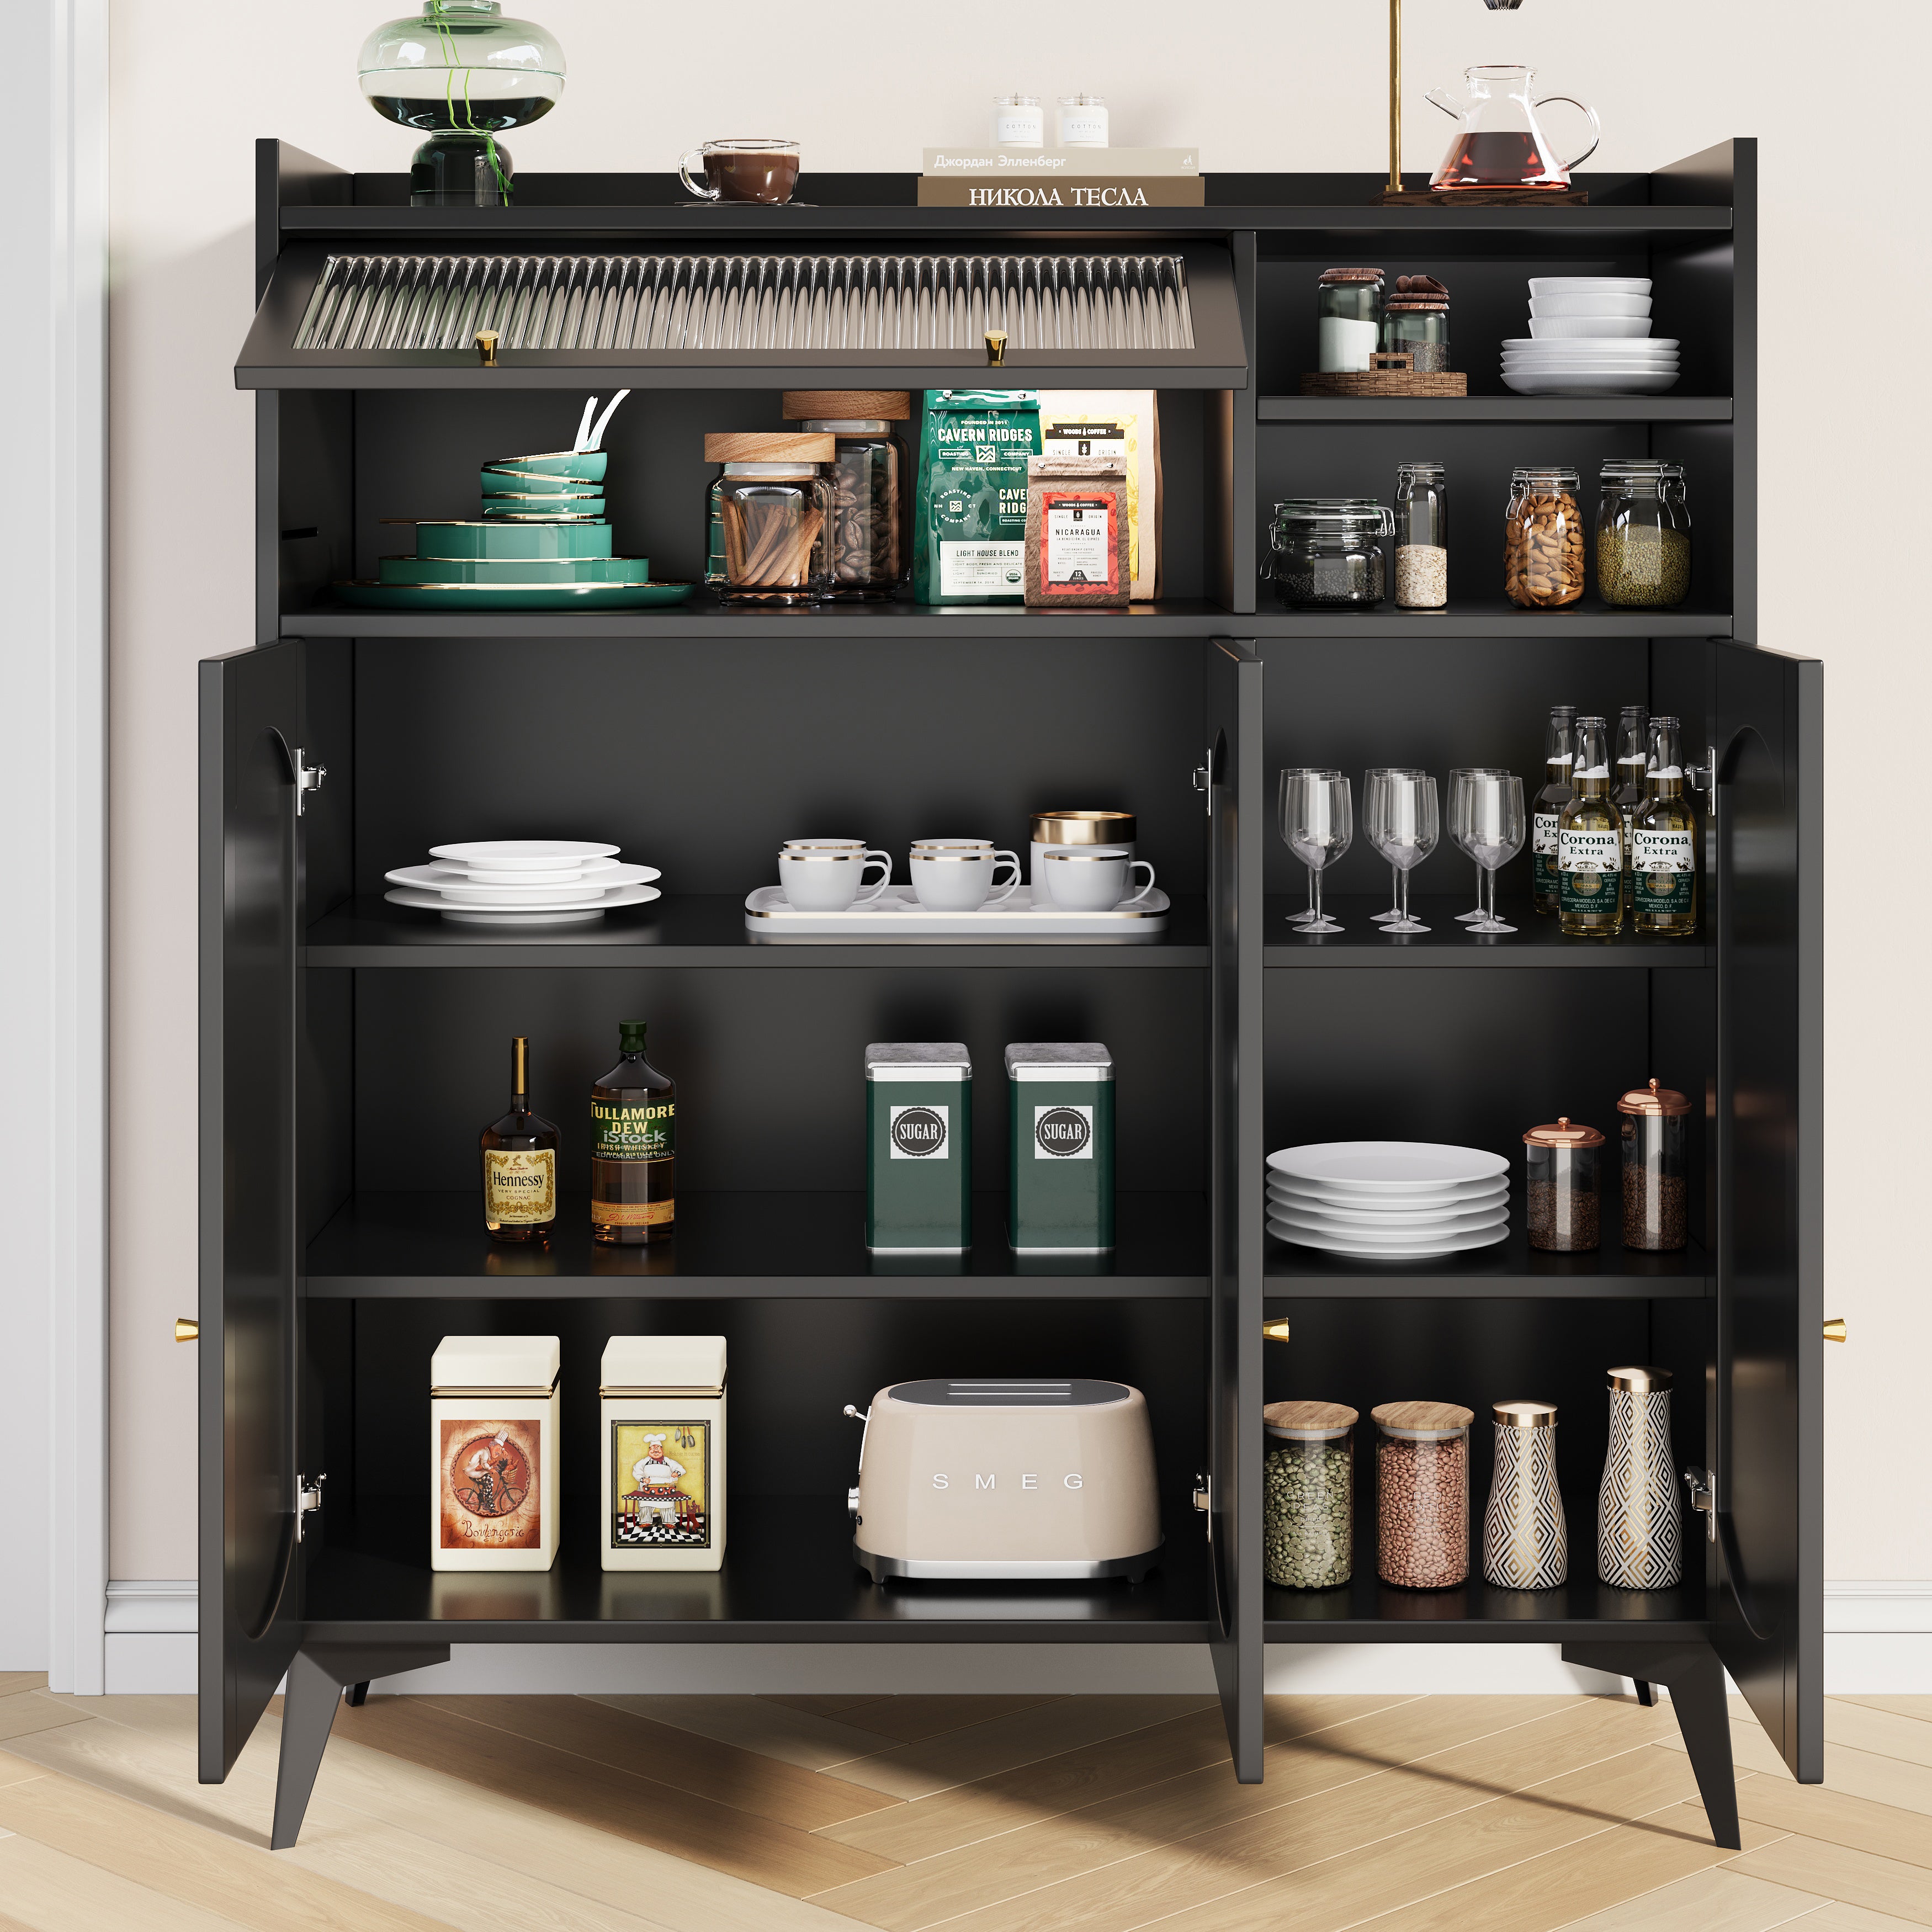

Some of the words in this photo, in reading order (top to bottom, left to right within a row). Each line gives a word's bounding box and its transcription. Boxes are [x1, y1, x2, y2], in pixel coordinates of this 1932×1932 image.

[934, 155, 992, 169] Джордан
[998, 155, 1066, 169] Элленберг
[969, 188, 1064, 206] НИКОЛА
[1071, 187, 1149, 206] ТЕСЛА
[938, 428, 985, 442] CAVERN
[989, 428, 1033, 442] RIDGES
[940, 489, 971, 499] ROASTING
[999, 489, 1028, 500] CAVE
[999, 502, 1027, 513] RIDG
[941, 514, 971, 523] COMPANY
[1535, 816, 1558, 829] Cor
[1561, 833, 1614, 845] Corona
[1634, 833, 1689, 845] Corona
[1570, 847, 1604, 855] Extra
[1644, 847, 1678, 855] Extra
[591, 1102, 675, 1120] TULLAMORE
[612, 1122, 648, 1134] DEW
[900, 1124, 938, 1140] SUGAR
[1044, 1124, 1082, 1140] SUGAR
[603, 1130, 667, 1144] iStock
[598, 1143, 620, 1151] IRISH
[624, 1142, 665, 1151] WHISKEY
[493, 1171, 544, 1188] Hennessy
[932, 1473, 1083, 1489] SMEG
[1287, 1492, 1333, 1500] GREEN
[1414, 1492, 1442, 1500] RED
[1293, 1503, 1329, 1511] PEAS
[1400, 1502, 1454, 1510] LENTILS
[461, 1520, 524, 1542] Boulangerie
